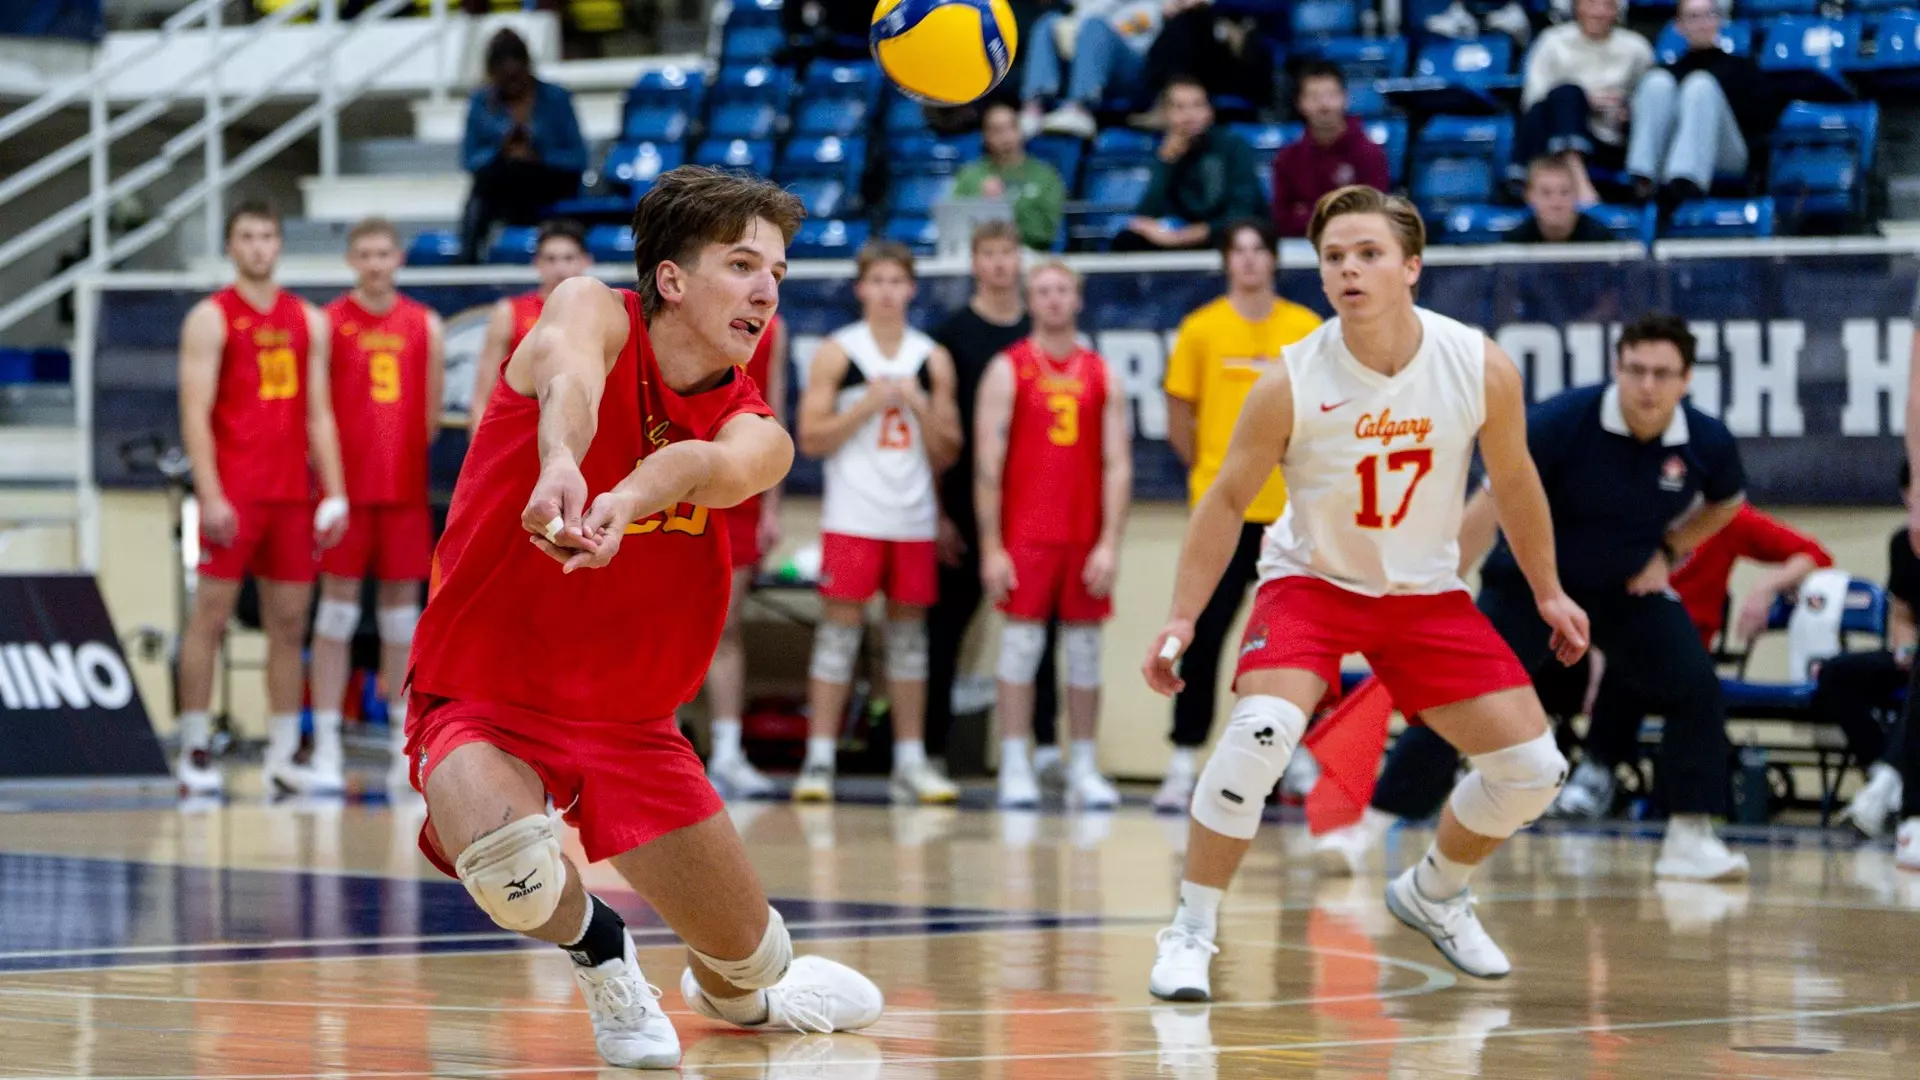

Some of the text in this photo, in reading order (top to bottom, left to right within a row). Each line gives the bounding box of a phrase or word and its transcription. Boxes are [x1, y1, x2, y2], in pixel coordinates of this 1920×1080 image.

[370, 351, 400, 404] 9
[1048, 394, 1079, 447] 3
[1355, 407, 1434, 446] Calgary
[1354, 447, 1434, 530] 17
